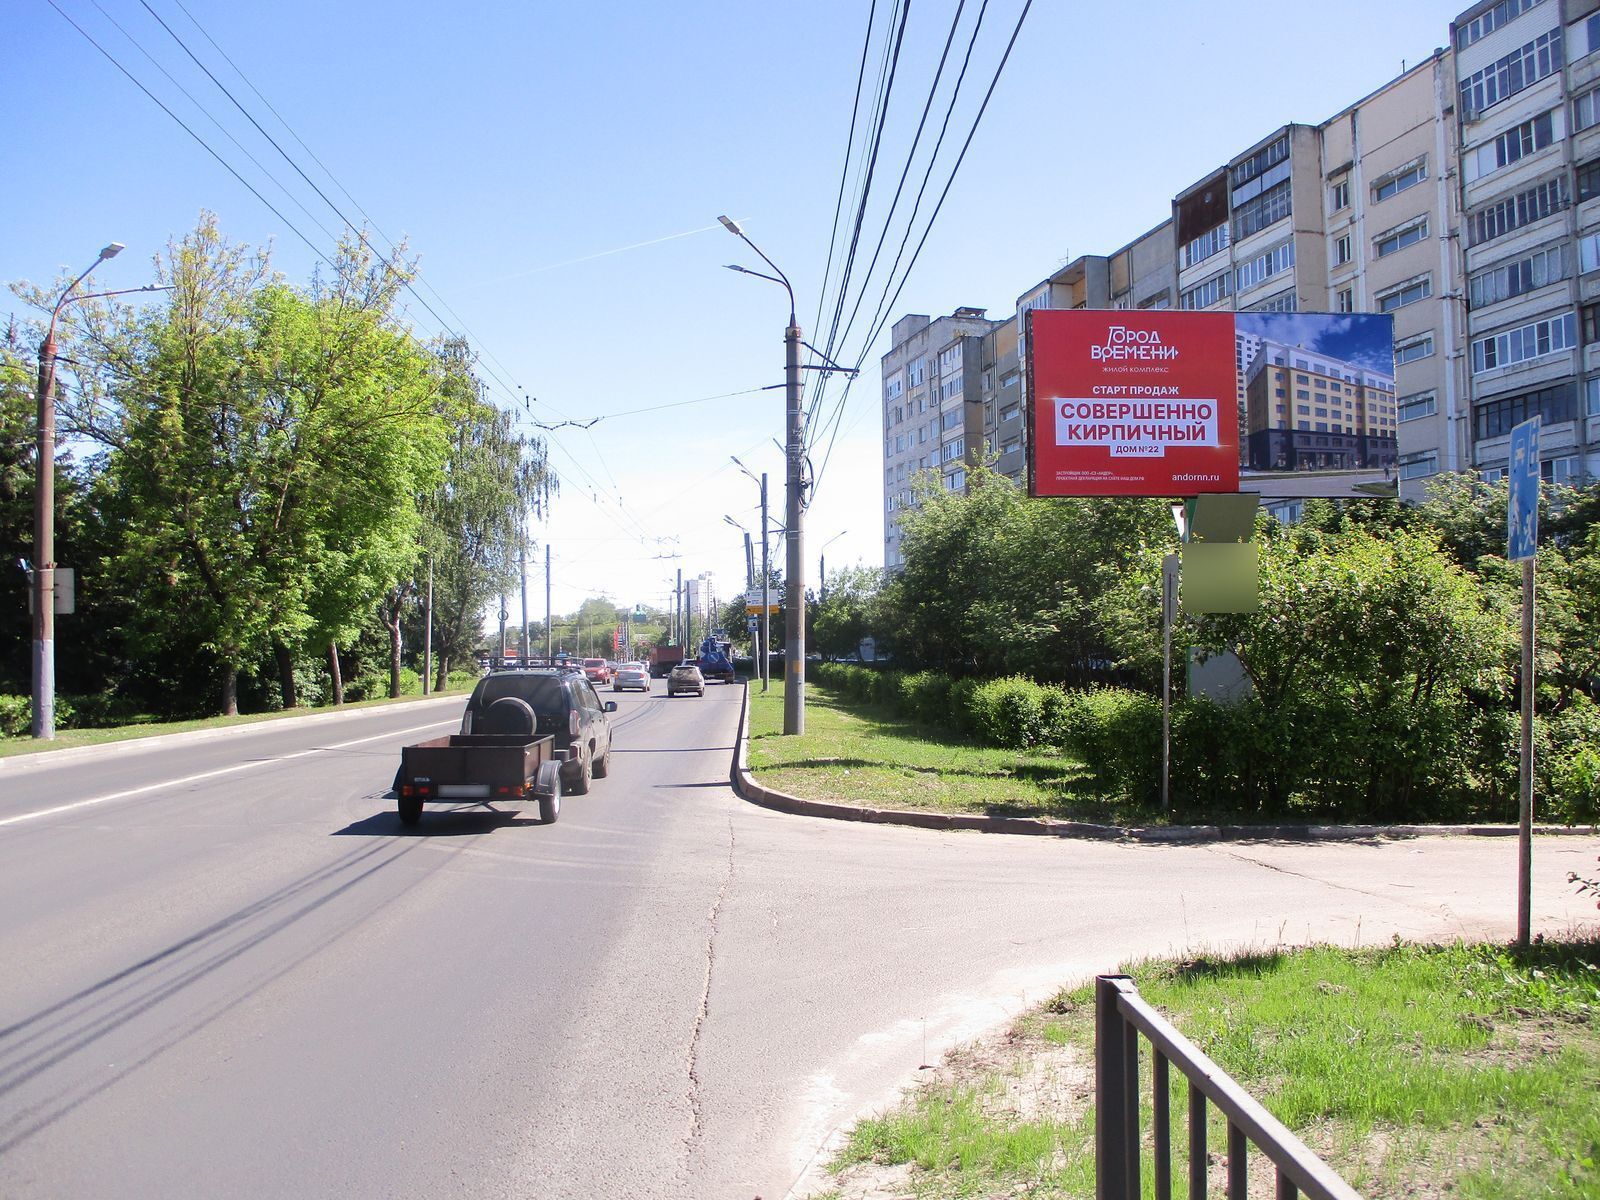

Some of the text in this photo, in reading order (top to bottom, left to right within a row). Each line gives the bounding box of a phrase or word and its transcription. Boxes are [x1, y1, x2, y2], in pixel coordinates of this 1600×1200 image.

[1109, 326, 1161, 347] ГОРОД
[1091, 346, 1176, 362] ВРЕМЕНИ
[1092, 385, 1179, 396] СТАРТ ПРОДАЖ
[1061, 403, 1212, 420] СОВЕРШЕННО
[1068, 422, 1206, 441] КИРПИЧНЫЙ
[1116, 446, 1159, 454] ДОМ №22
[1172, 473, 1220, 482] andornn.ru
